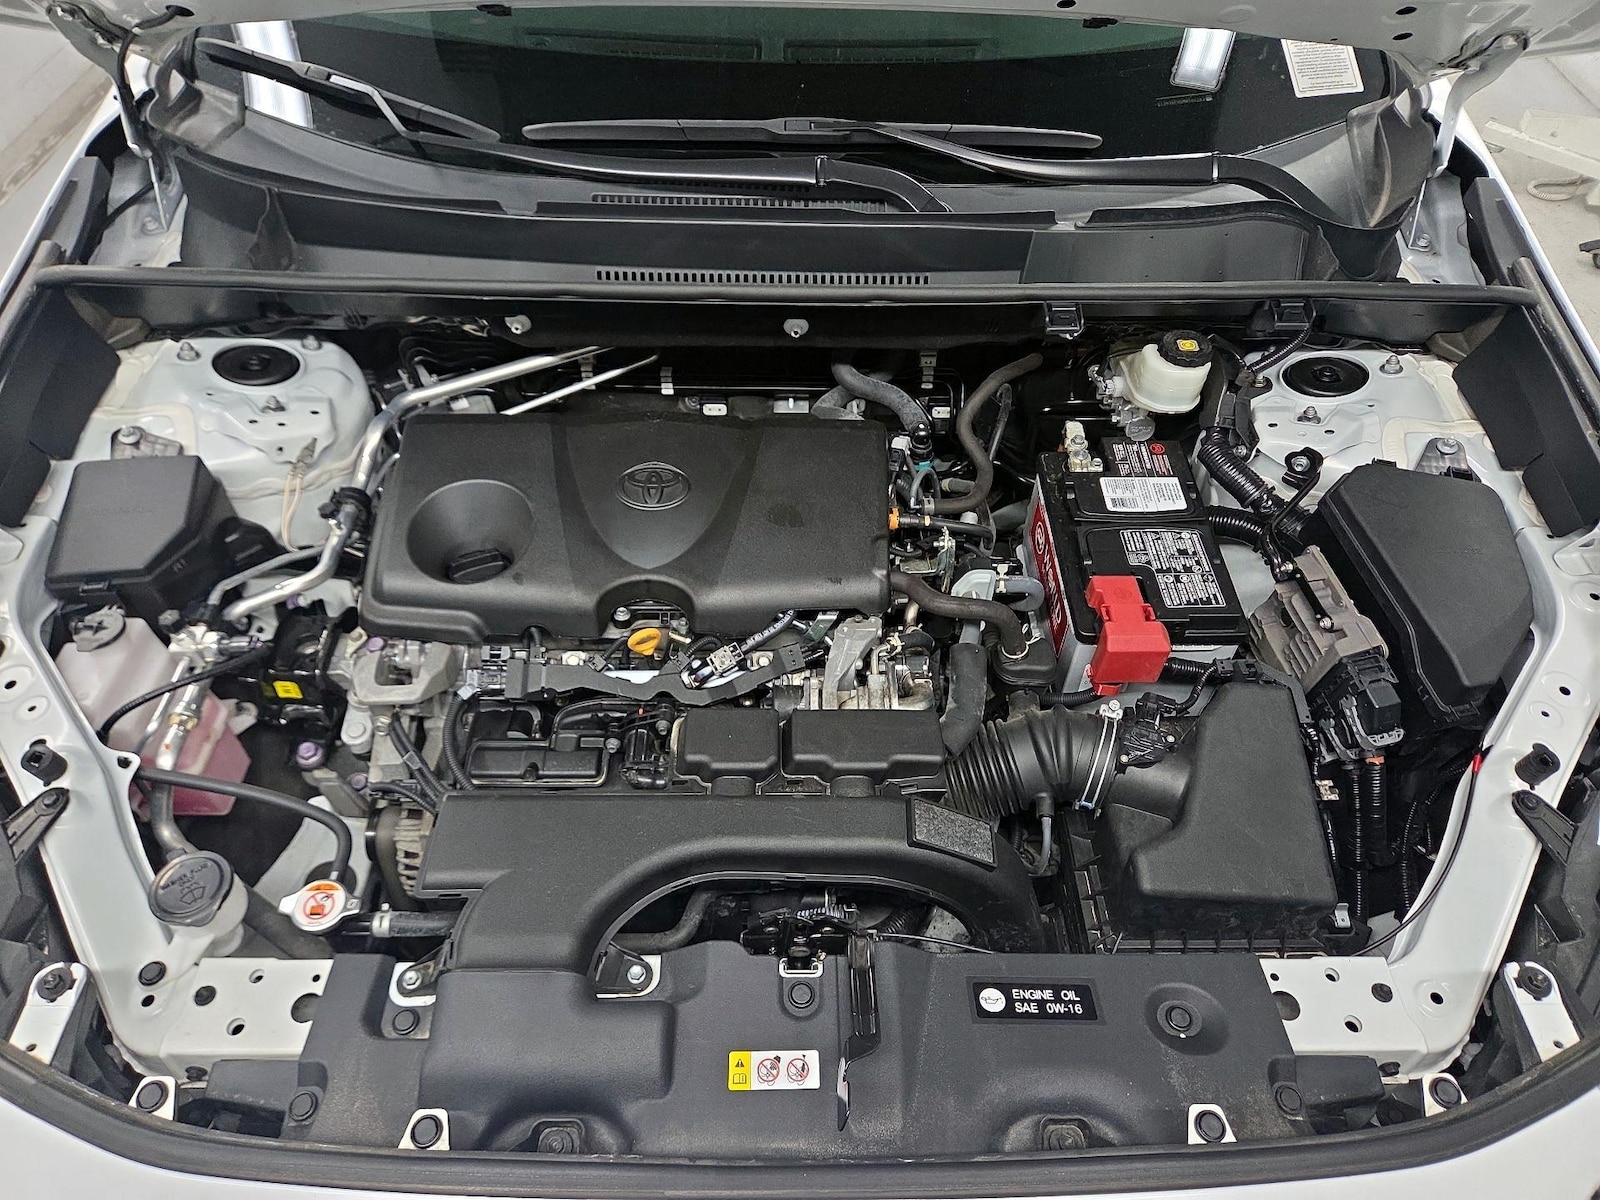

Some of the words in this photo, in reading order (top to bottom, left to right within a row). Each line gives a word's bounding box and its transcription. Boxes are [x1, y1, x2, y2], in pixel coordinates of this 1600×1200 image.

[1011, 988, 1055, 1001] ENGINE
[1060, 989, 1081, 1001] OIL
[1014, 1002, 1040, 1013] SAE
[1045, 1003, 1083, 1014] 0W-16
